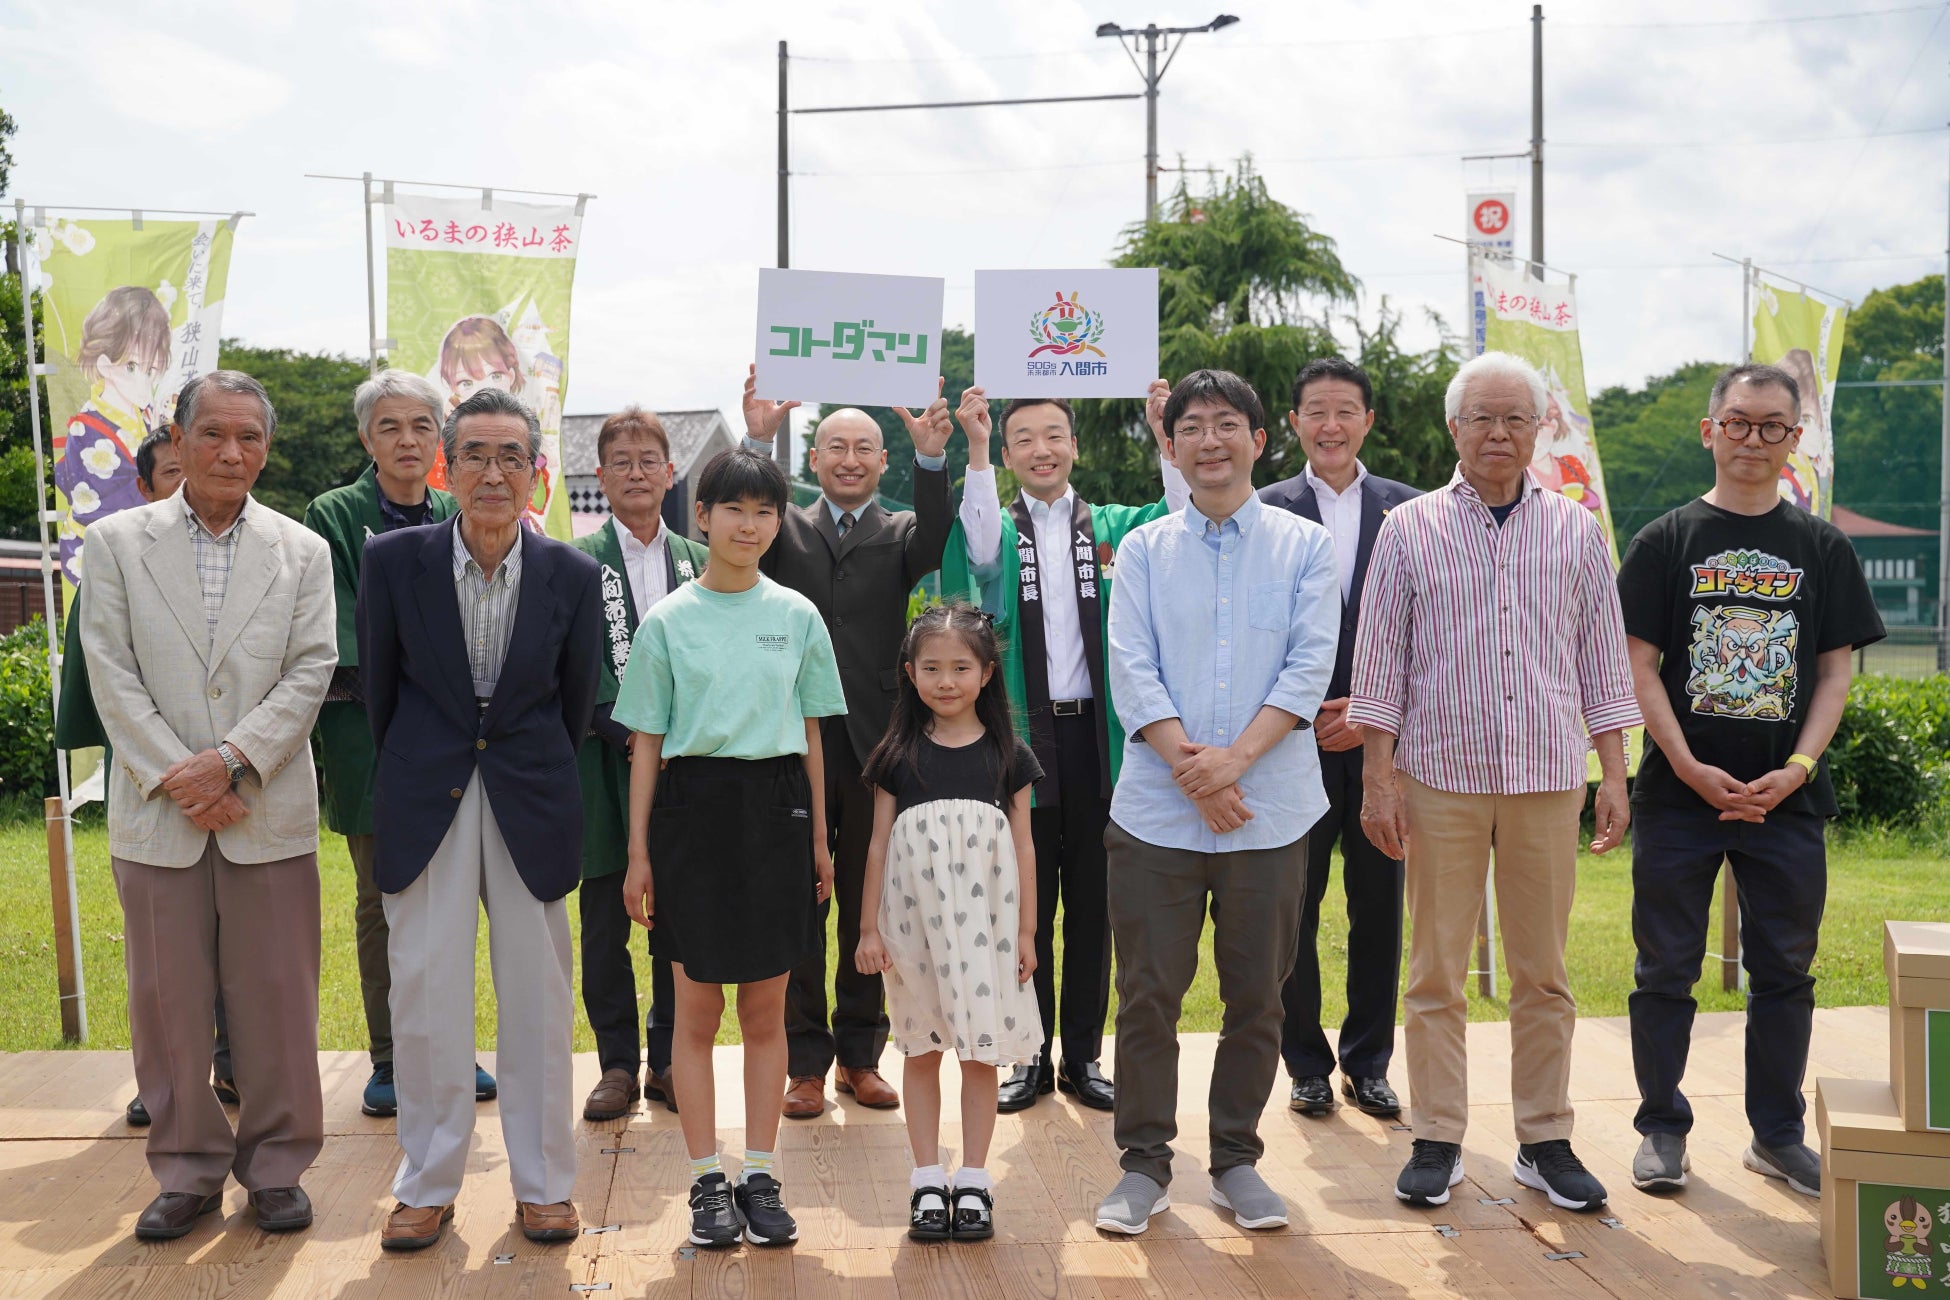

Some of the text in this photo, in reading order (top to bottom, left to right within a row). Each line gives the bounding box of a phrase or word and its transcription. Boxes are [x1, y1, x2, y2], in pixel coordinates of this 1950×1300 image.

[1480, 205, 1503, 228] 祝
[395, 218, 573, 253] いるまの狭山茶
[769, 319, 928, 364] コトダマン
[1059, 361, 1108, 376] 入間市
[1017, 531, 1039, 602] 入間市長
[1075, 530, 1097, 599] 入間市長
[1695, 566, 1801, 598] コトダマン
